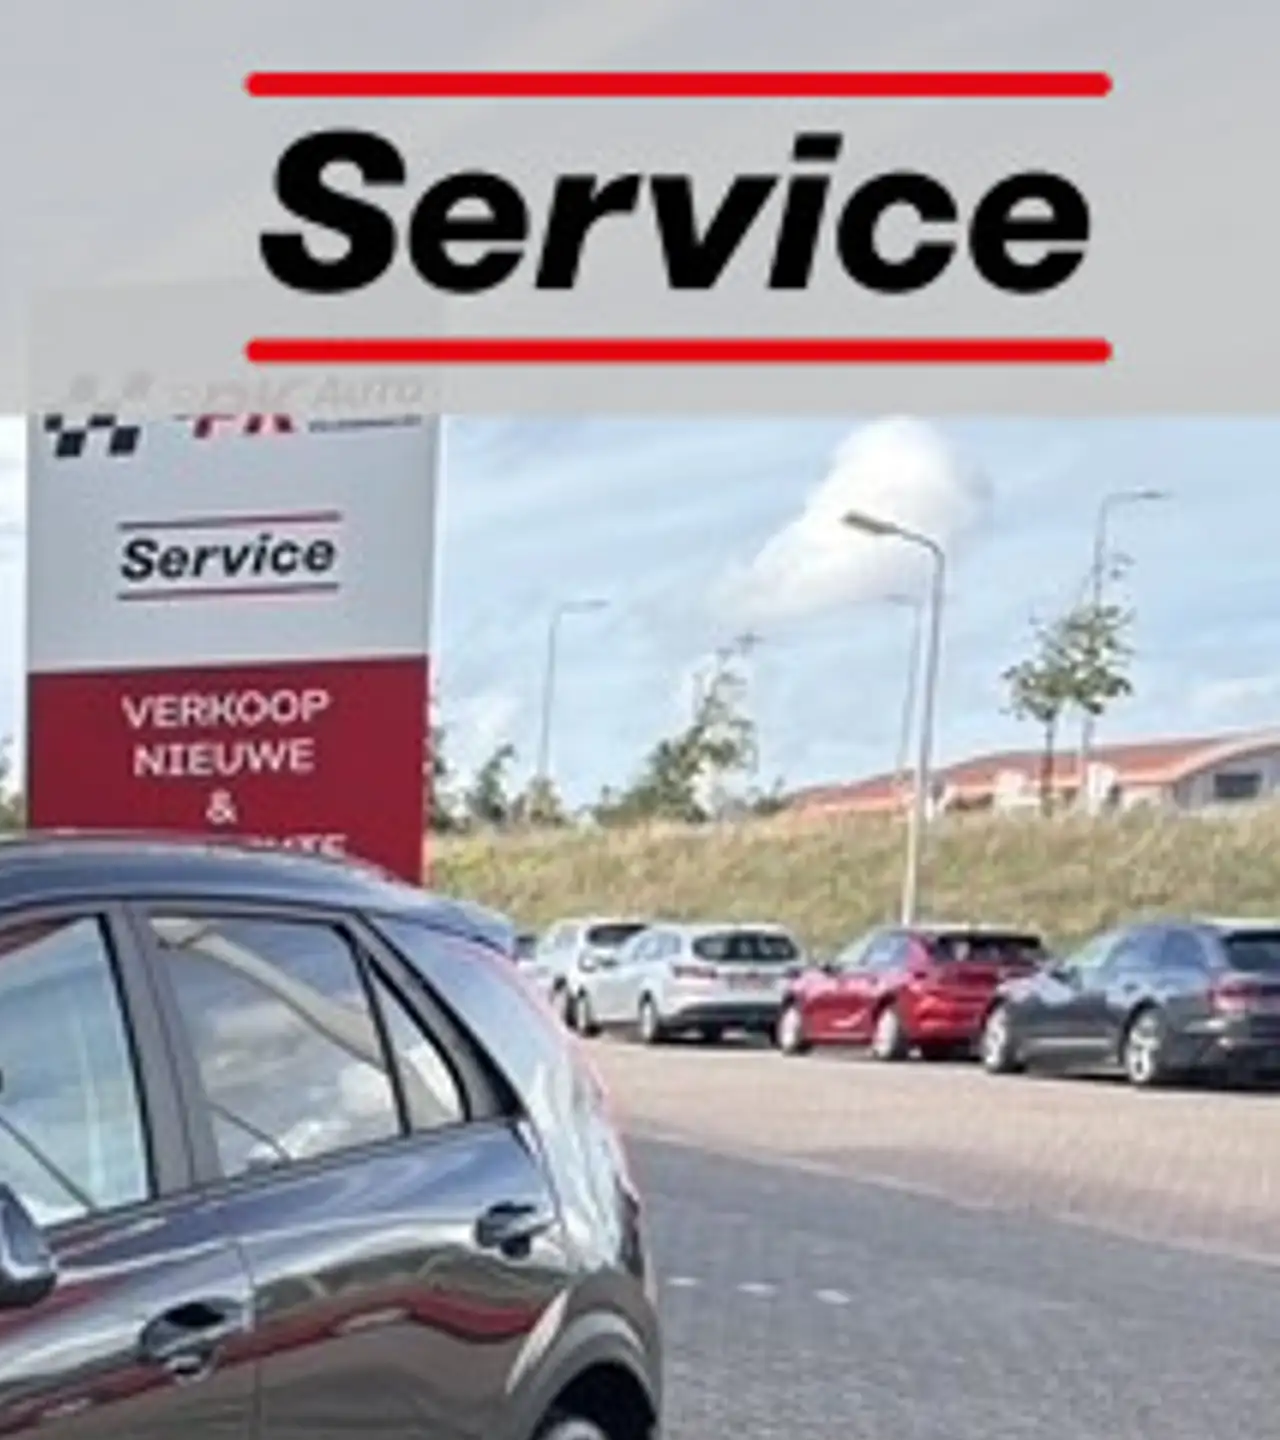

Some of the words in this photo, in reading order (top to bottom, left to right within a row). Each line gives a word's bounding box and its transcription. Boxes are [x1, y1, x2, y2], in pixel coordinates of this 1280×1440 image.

[120, 533, 336, 582] Service
[122, 689, 330, 729] VERKOOP
[134, 738, 315, 777] NIEUWE
[206, 790, 236, 824] &
